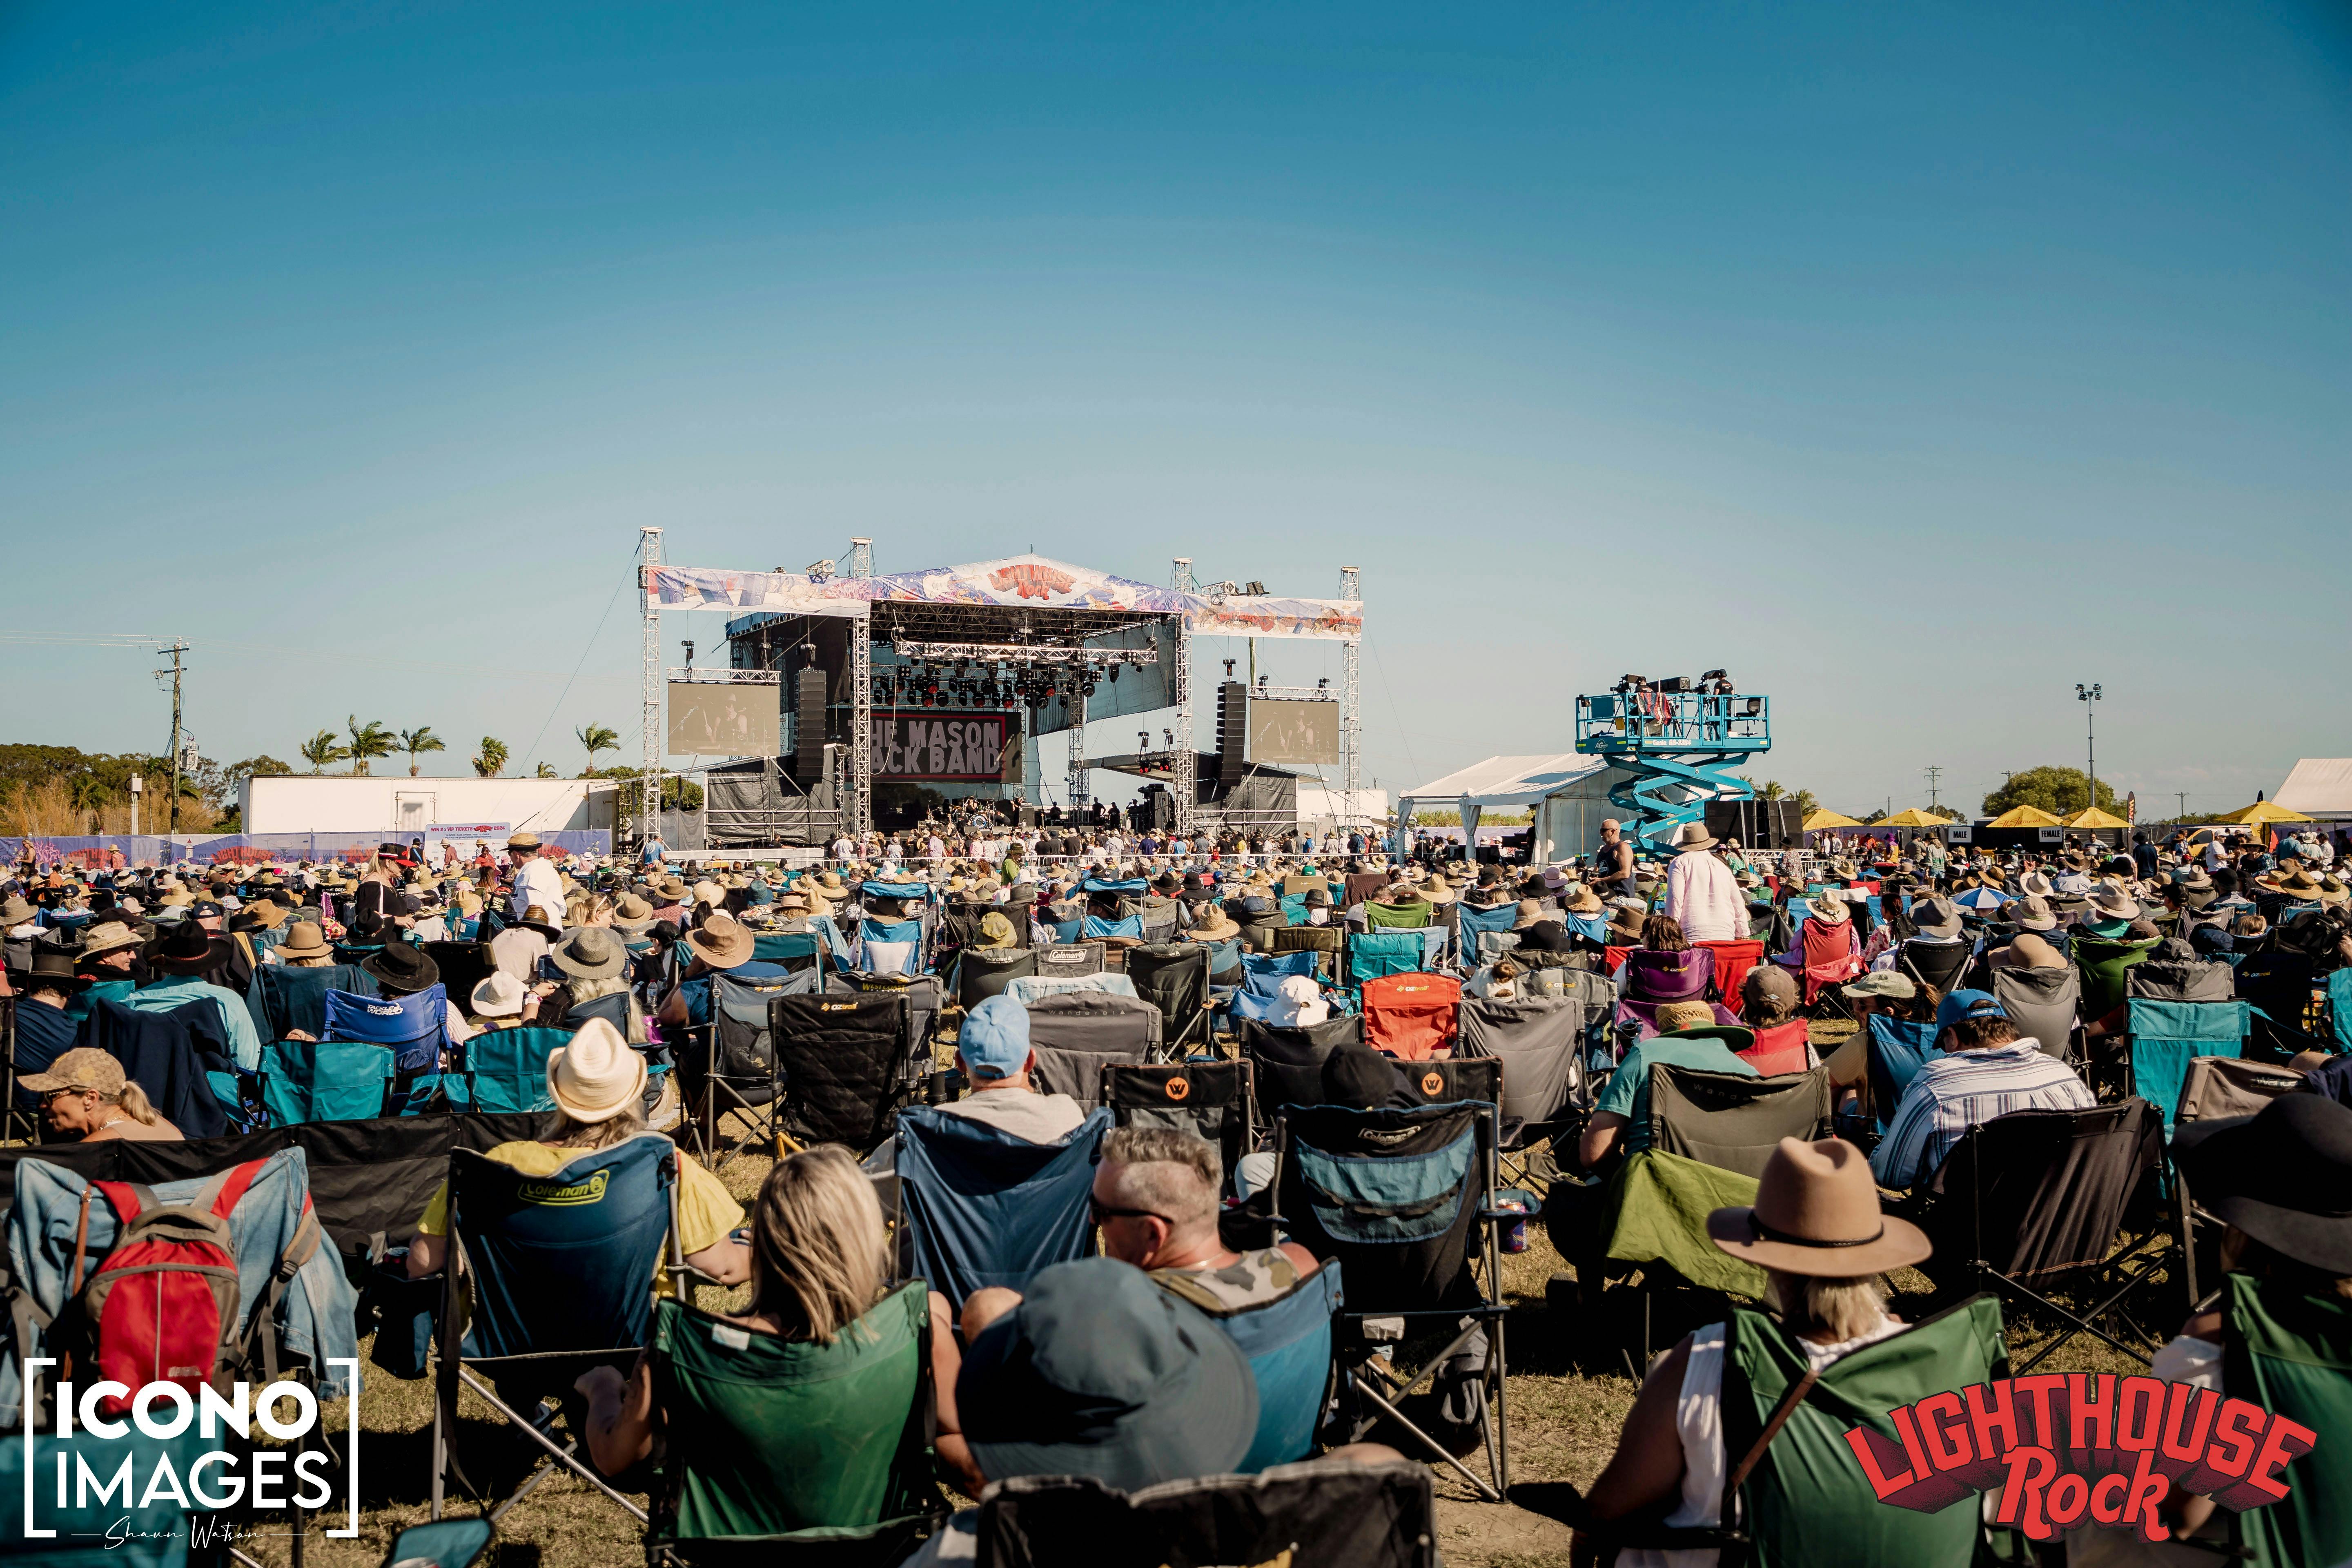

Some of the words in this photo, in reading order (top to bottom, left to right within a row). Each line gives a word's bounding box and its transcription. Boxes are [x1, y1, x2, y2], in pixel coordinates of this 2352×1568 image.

[987, 564, 1077, 593] LIGHTHOUSE
[909, 721, 999, 749] MASON
[848, 746, 903, 773] ACK
[929, 747, 1000, 774] BAND
[62, 847, 127, 864] LIGHTHOU
[211, 846, 275, 864] LIGHTHOUSE
